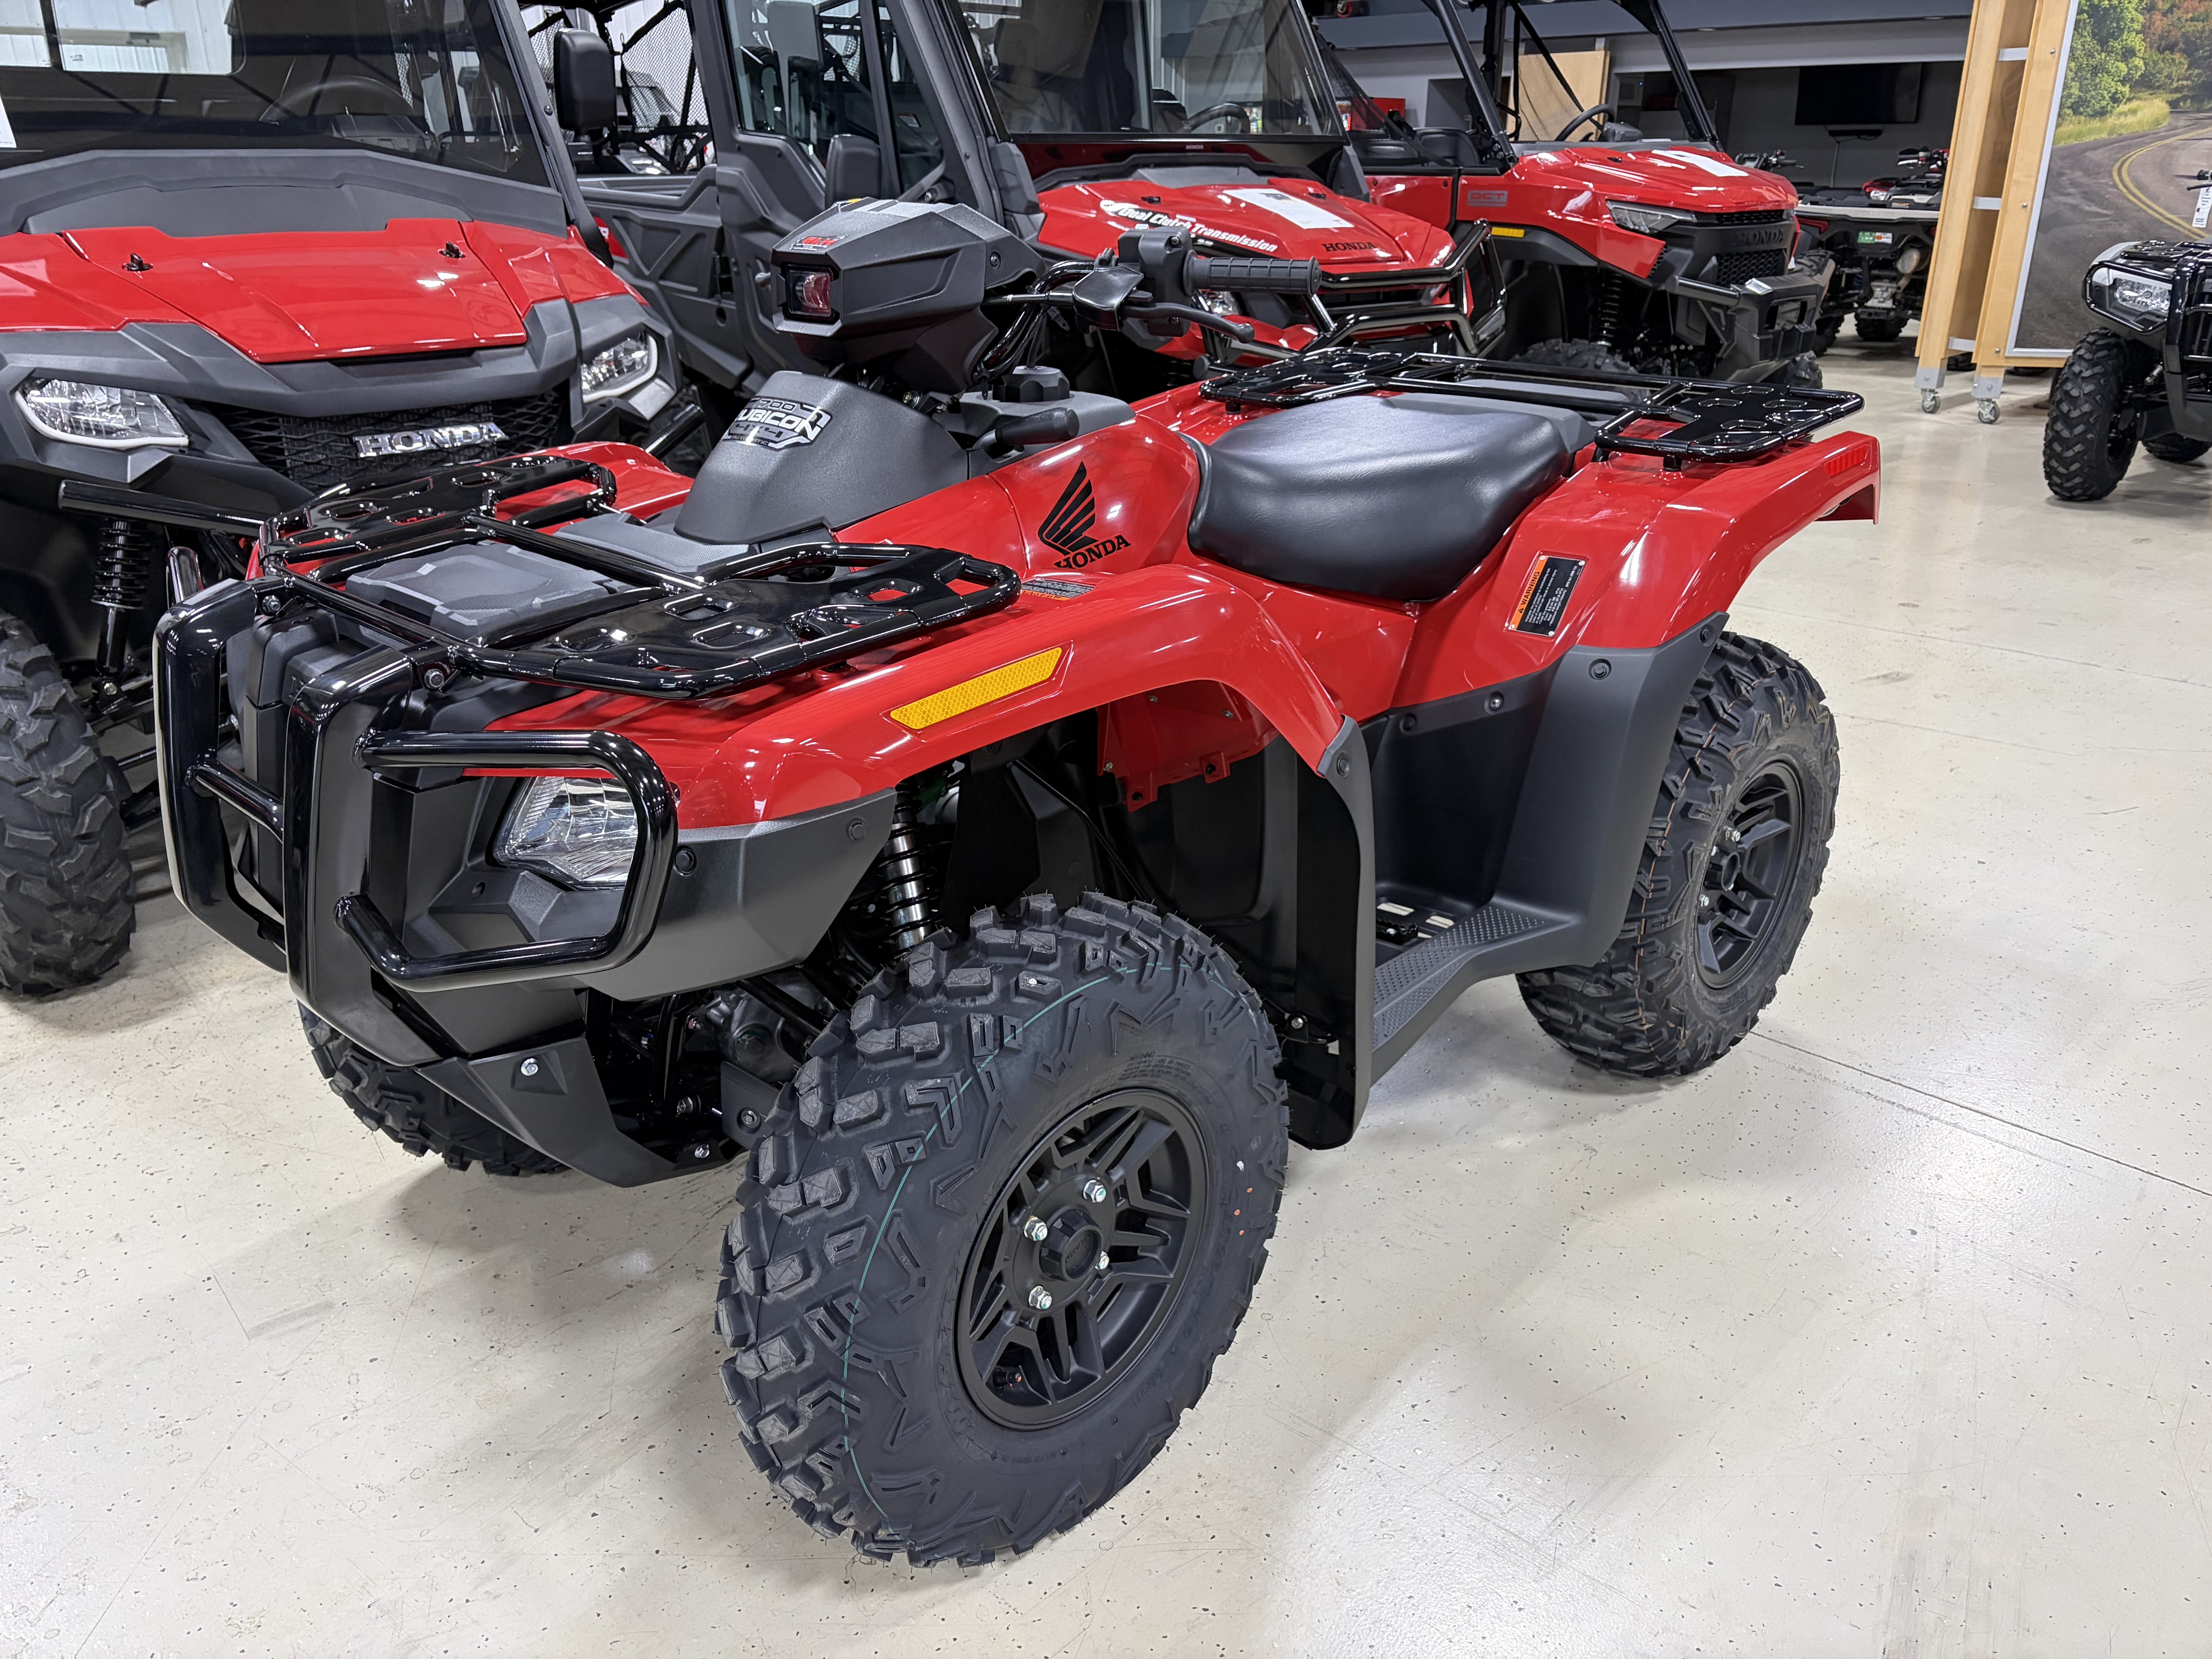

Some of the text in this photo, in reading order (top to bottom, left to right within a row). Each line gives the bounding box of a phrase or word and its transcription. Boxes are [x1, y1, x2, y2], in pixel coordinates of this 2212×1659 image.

[1118, 208, 1152, 221] Dual
[1191, 223, 1278, 252] Transmission
[1322, 241, 1376, 252] HONDA
[758, 398, 798, 413] 700
[352, 422, 510, 458] HONDA
[734, 409, 821, 441] UBICON
[1053, 534, 1131, 569] HONDA
[1520, 571, 1540, 606] WARNING
